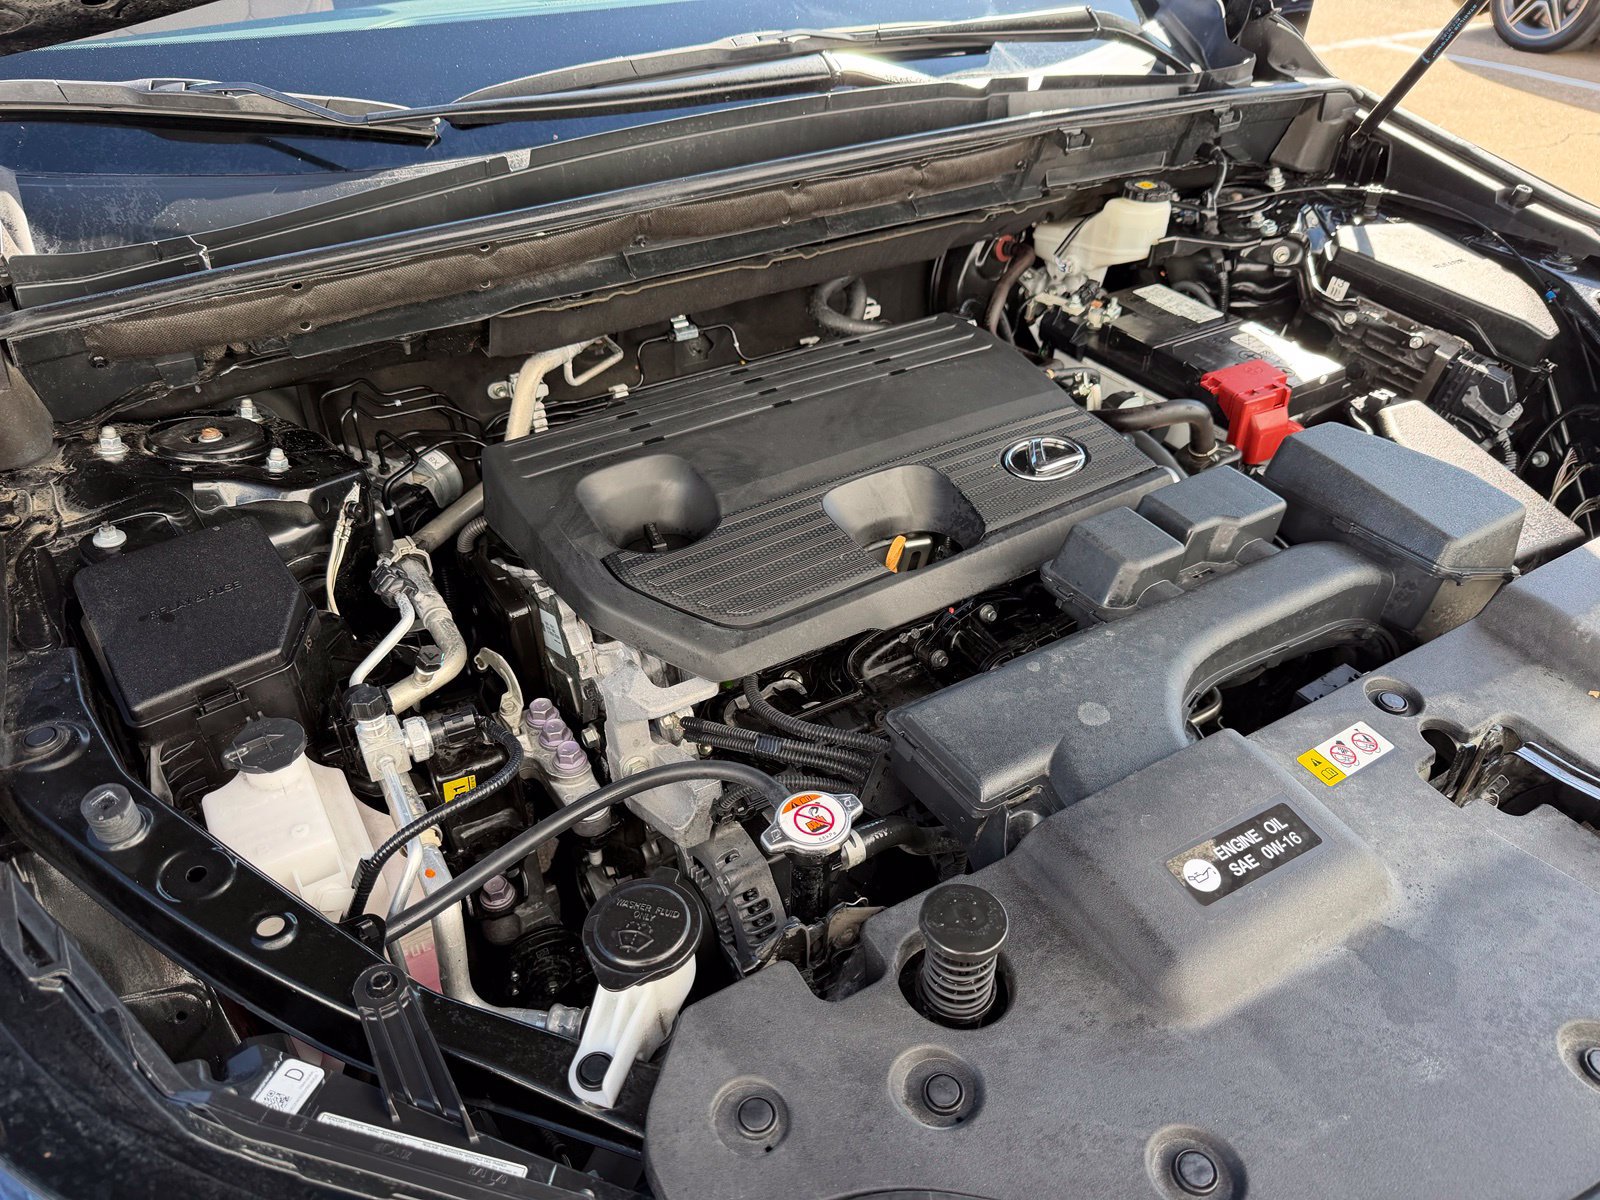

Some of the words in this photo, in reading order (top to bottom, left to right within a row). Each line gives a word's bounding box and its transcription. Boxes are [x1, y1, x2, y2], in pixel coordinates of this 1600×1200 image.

[1213, 829, 1263, 861] ENGINE
[1263, 817, 1289, 835] OIL
[1228, 854, 1260, 877] SAE
[1261, 831, 1302, 860] 0W-16
[616, 898, 652, 913] WASHER
[655, 906, 681, 919] FLUID
[633, 910, 657, 921] ONLY
[284, 1068, 305, 1082] D
